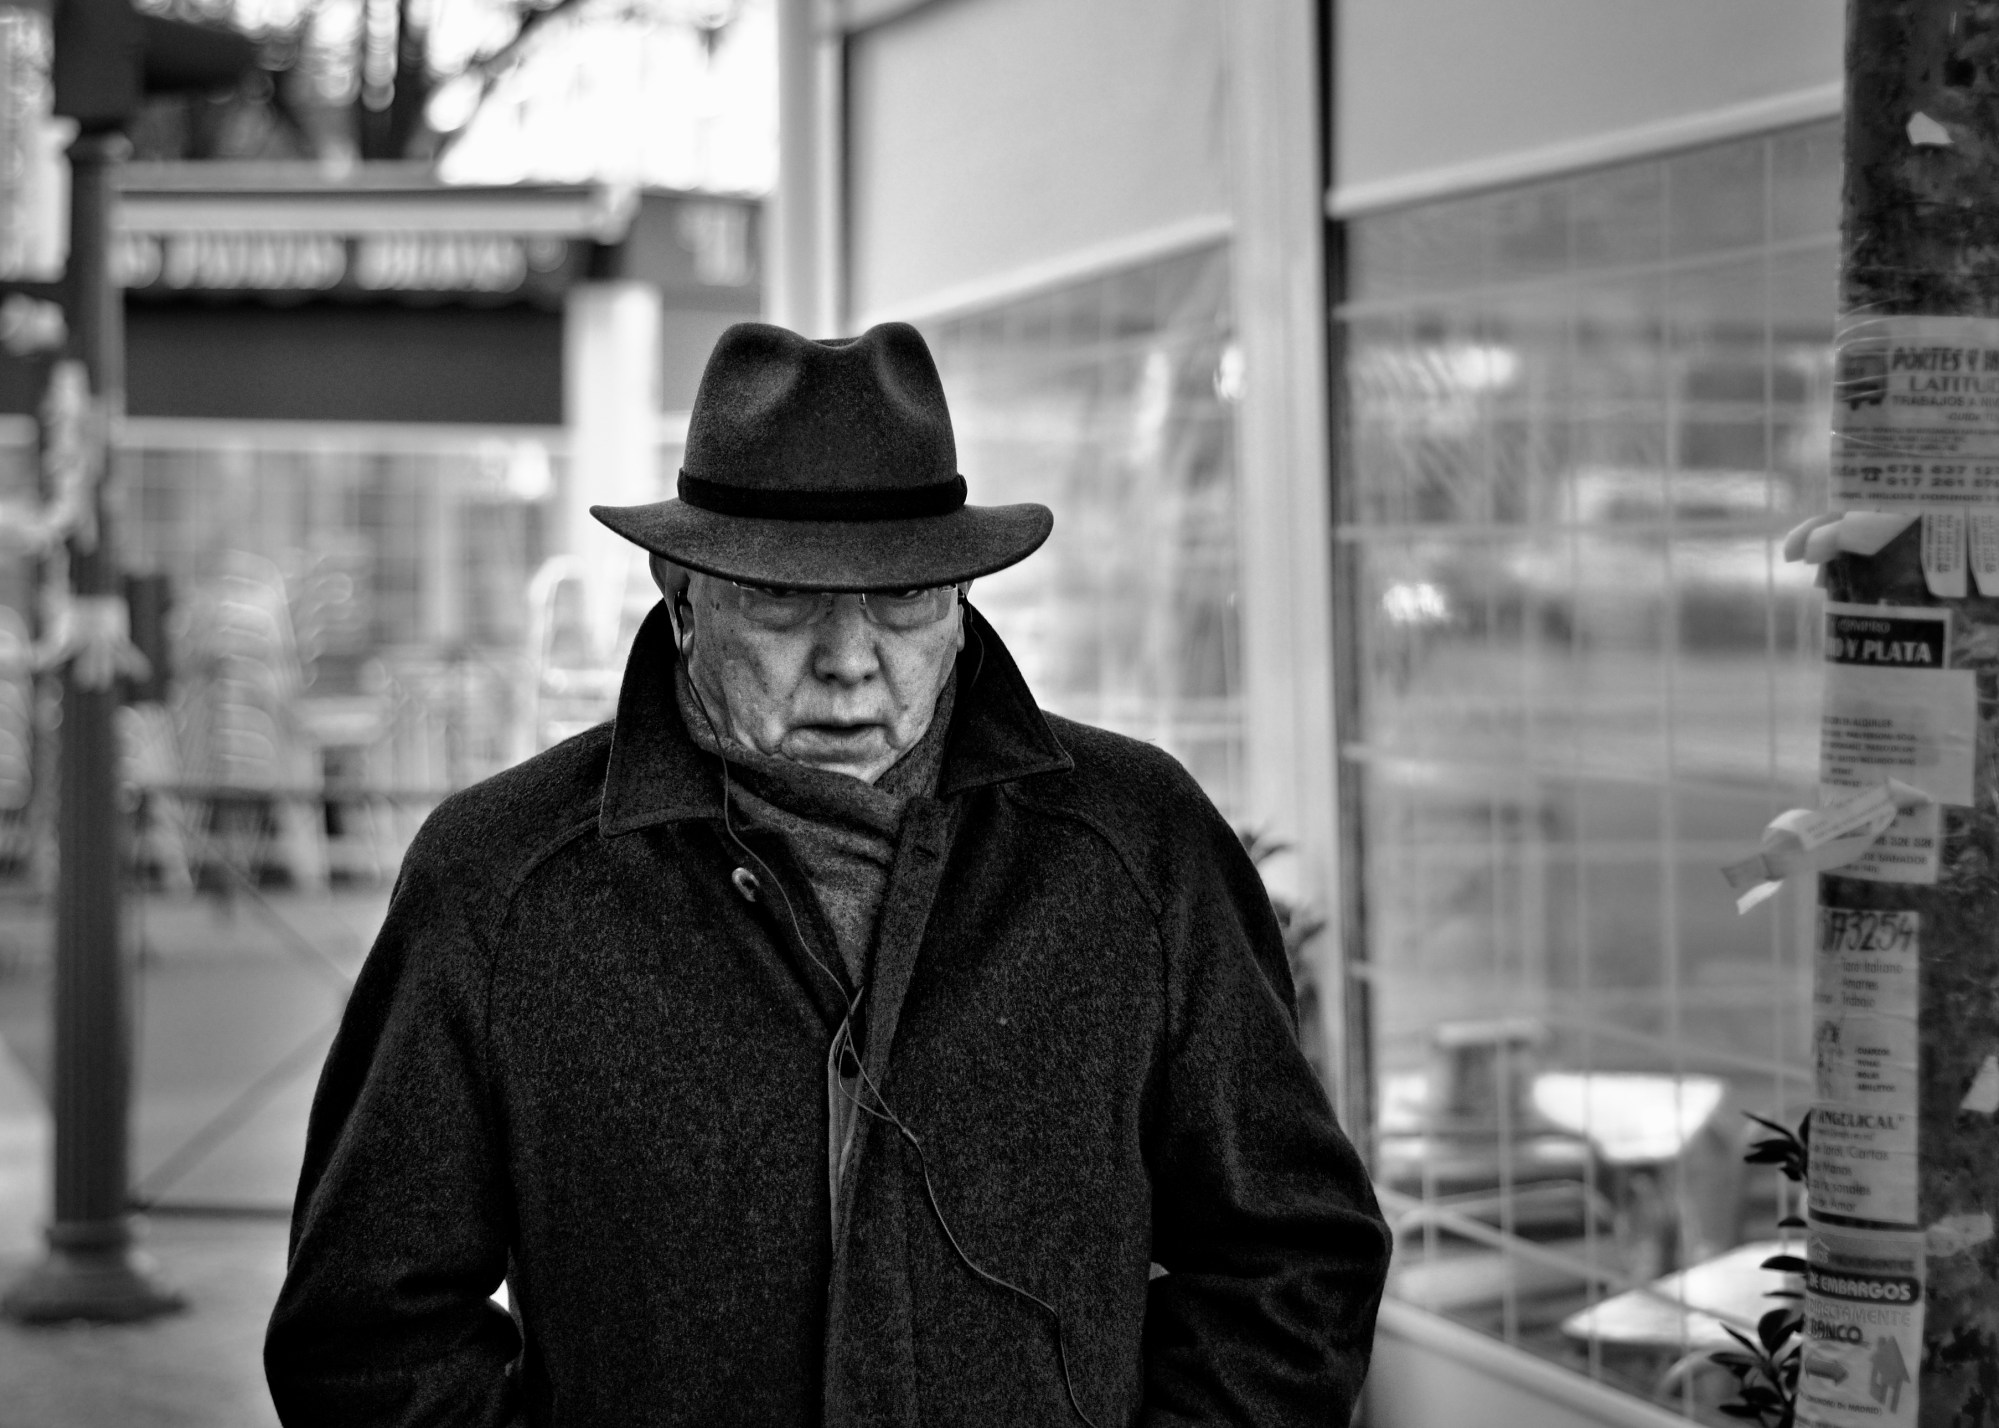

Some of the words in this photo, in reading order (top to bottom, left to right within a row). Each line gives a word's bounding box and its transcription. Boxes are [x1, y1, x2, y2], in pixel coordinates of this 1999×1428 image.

[1891, 347, 1962, 371] PORTES
[1892, 395, 1965, 407] TRABAJOS
[1846, 638, 1859, 658] Y
[1863, 639, 1932, 663] PLATA
[1807, 1270, 1819, 1289] DE
[1820, 1276, 1912, 1302] EMBARGOS
[1808, 1298, 1913, 1328] DIRECTAMENTE
[1810, 1318, 1864, 1344] BANCO
